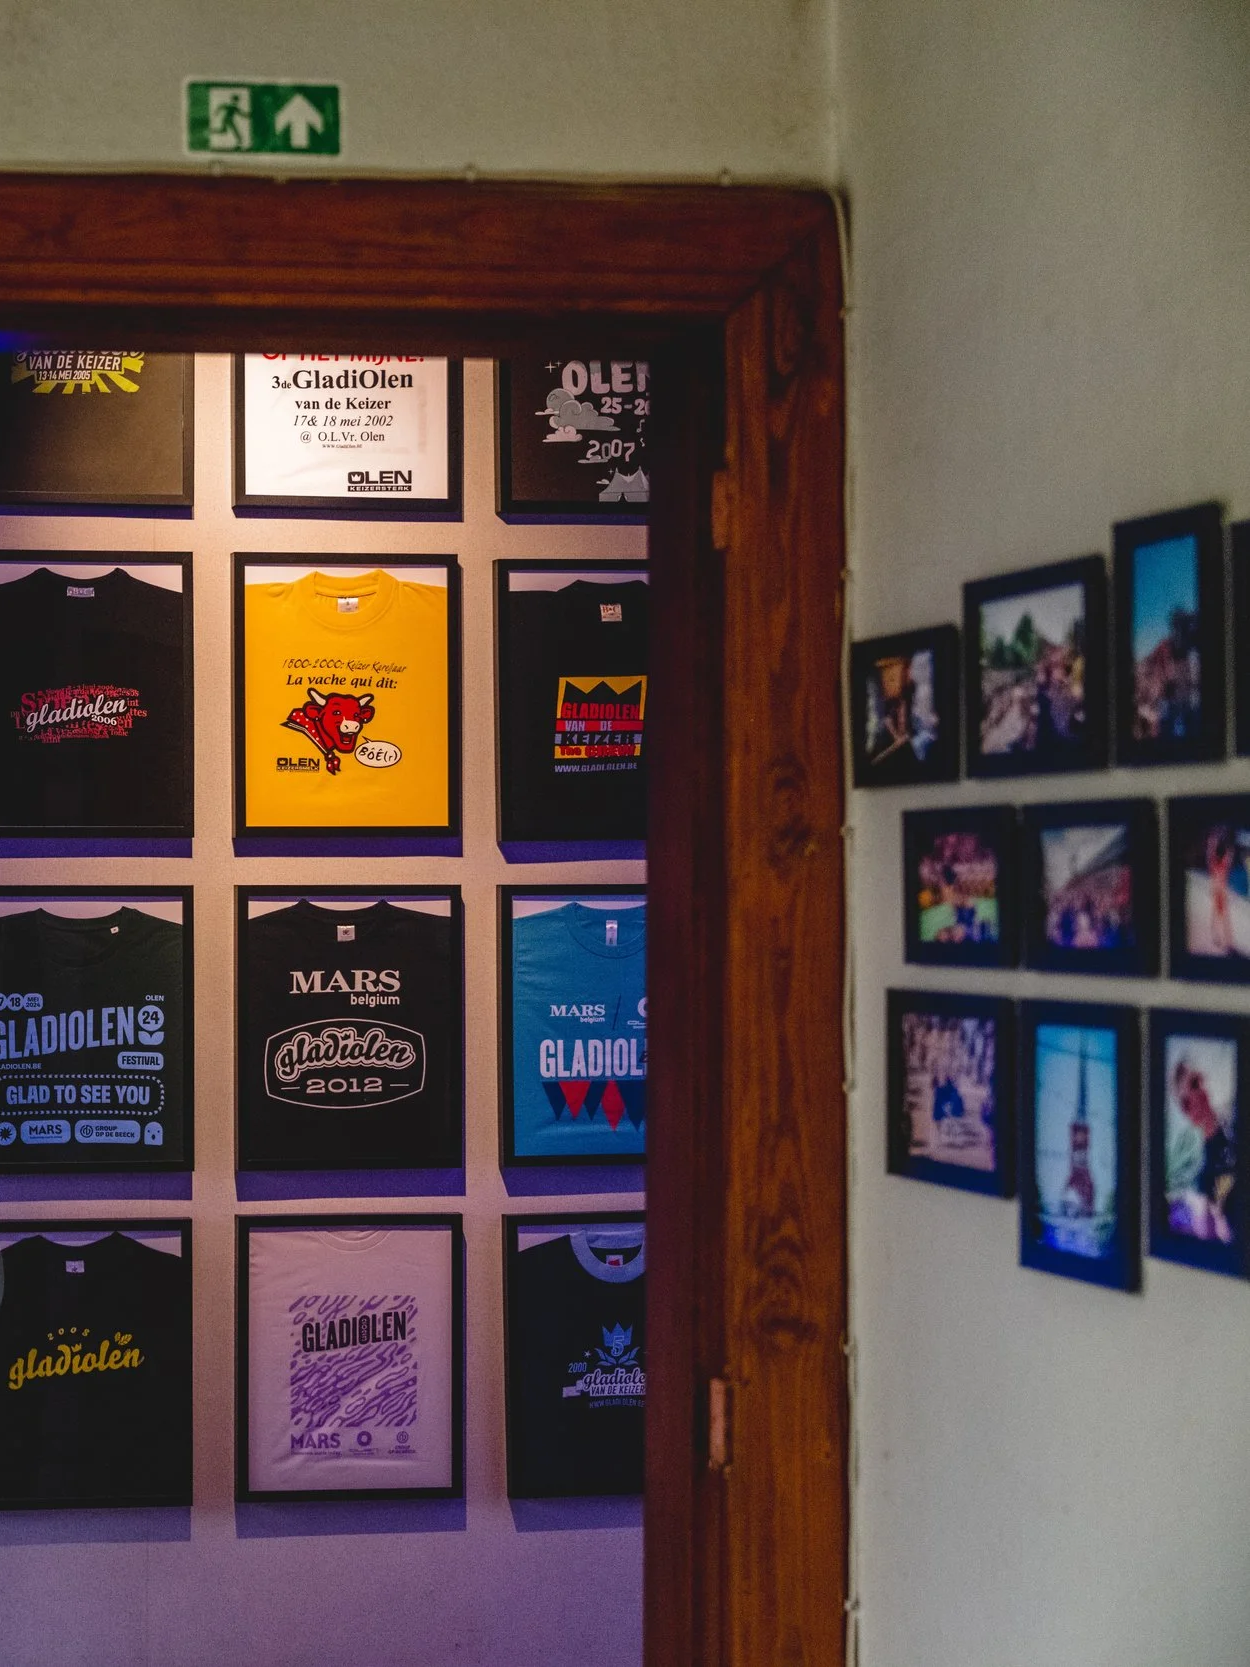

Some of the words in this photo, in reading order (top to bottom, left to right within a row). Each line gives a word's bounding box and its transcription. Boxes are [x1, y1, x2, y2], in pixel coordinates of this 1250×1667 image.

[30, 356, 51, 370] VAN
[56, 355, 72, 369] DE
[77, 355, 121, 370] KEIZER
[58, 371, 70, 380] MEI
[73, 370, 91, 380] 2005
[292, 369, 413, 389] GladiOlen
[295, 400, 320, 410] van
[325, 398, 341, 410] de
[346, 397, 391, 410] Keizer
[323, 415, 337, 426] 18
[340, 416, 361, 426] mei
[364, 415, 393, 426] 2002
[360, 431, 385, 442] Olen
[586, 439, 635, 462] 2007
[348, 470, 412, 484] OLEN
[346, 659, 370, 672] Keizer
[286, 674, 303, 685] La
[307, 674, 346, 685] vache
[351, 676, 372, 688] qui
[376, 677, 398, 689] dit:
[26, 694, 128, 733] gladiolen
[561, 702, 640, 720] GLADIOLEN
[91, 714, 118, 726] 2006
[565, 721, 586, 731] VAN
[600, 721, 613, 731] DE
[277, 758, 320, 766] OLEN
[289, 970, 400, 994] MARS
[10, 997, 21, 1007] 18
[350, 994, 400, 1007] belgium
[141, 1010, 160, 1025] 24
[550, 1004, 605, 1017] MARS
[121, 1055, 161, 1066] FESTIVAL
[277, 1029, 414, 1079] gladiolen
[539, 1038, 647, 1078] GLADIOL
[306, 1077, 382, 1094] 2012
[6, 1085, 50, 1105] GLAD
[54, 1085, 76, 1104] TO
[80, 1085, 111, 1104] SEE
[115, 1085, 150, 1105] YOU
[29, 1124, 62, 1135] MARS
[47, 1327, 90, 1341] 2008
[302, 1311, 407, 1352] GLADIOLEN
[8, 1340, 145, 1390] gladiolen
[591, 1386, 605, 1395] VAN
[608, 1385, 617, 1394] DE
[619, 1384, 645, 1394] KEIZER
[291, 1432, 341, 1449] MARS
